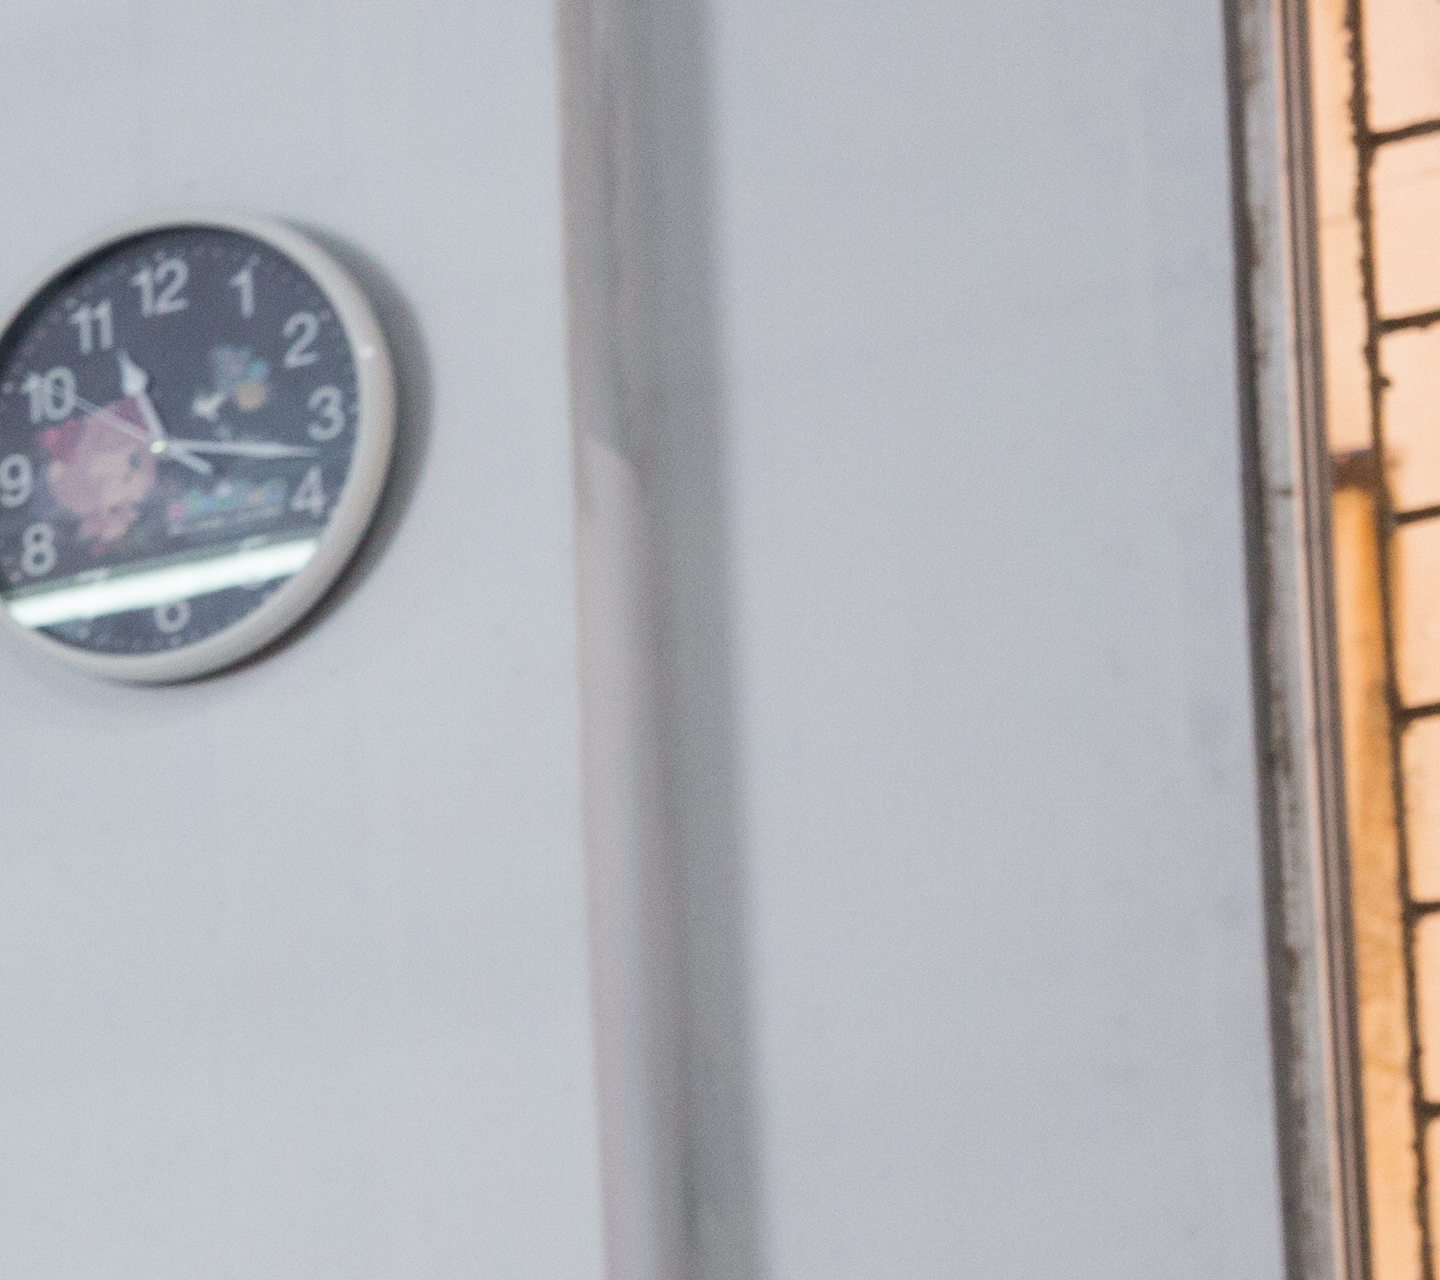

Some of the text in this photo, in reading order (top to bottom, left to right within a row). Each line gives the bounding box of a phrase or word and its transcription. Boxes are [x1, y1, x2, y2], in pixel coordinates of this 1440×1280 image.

[131, 259, 189, 318] 12
[230, 268, 257, 319] 1
[70, 301, 114, 354] 11
[282, 312, 319, 370] 2
[21, 366, 78, 425] 10
[307, 385, 347, 442] 3
[291, 466, 327, 518] 4
[21, 522, 58, 577] 8
